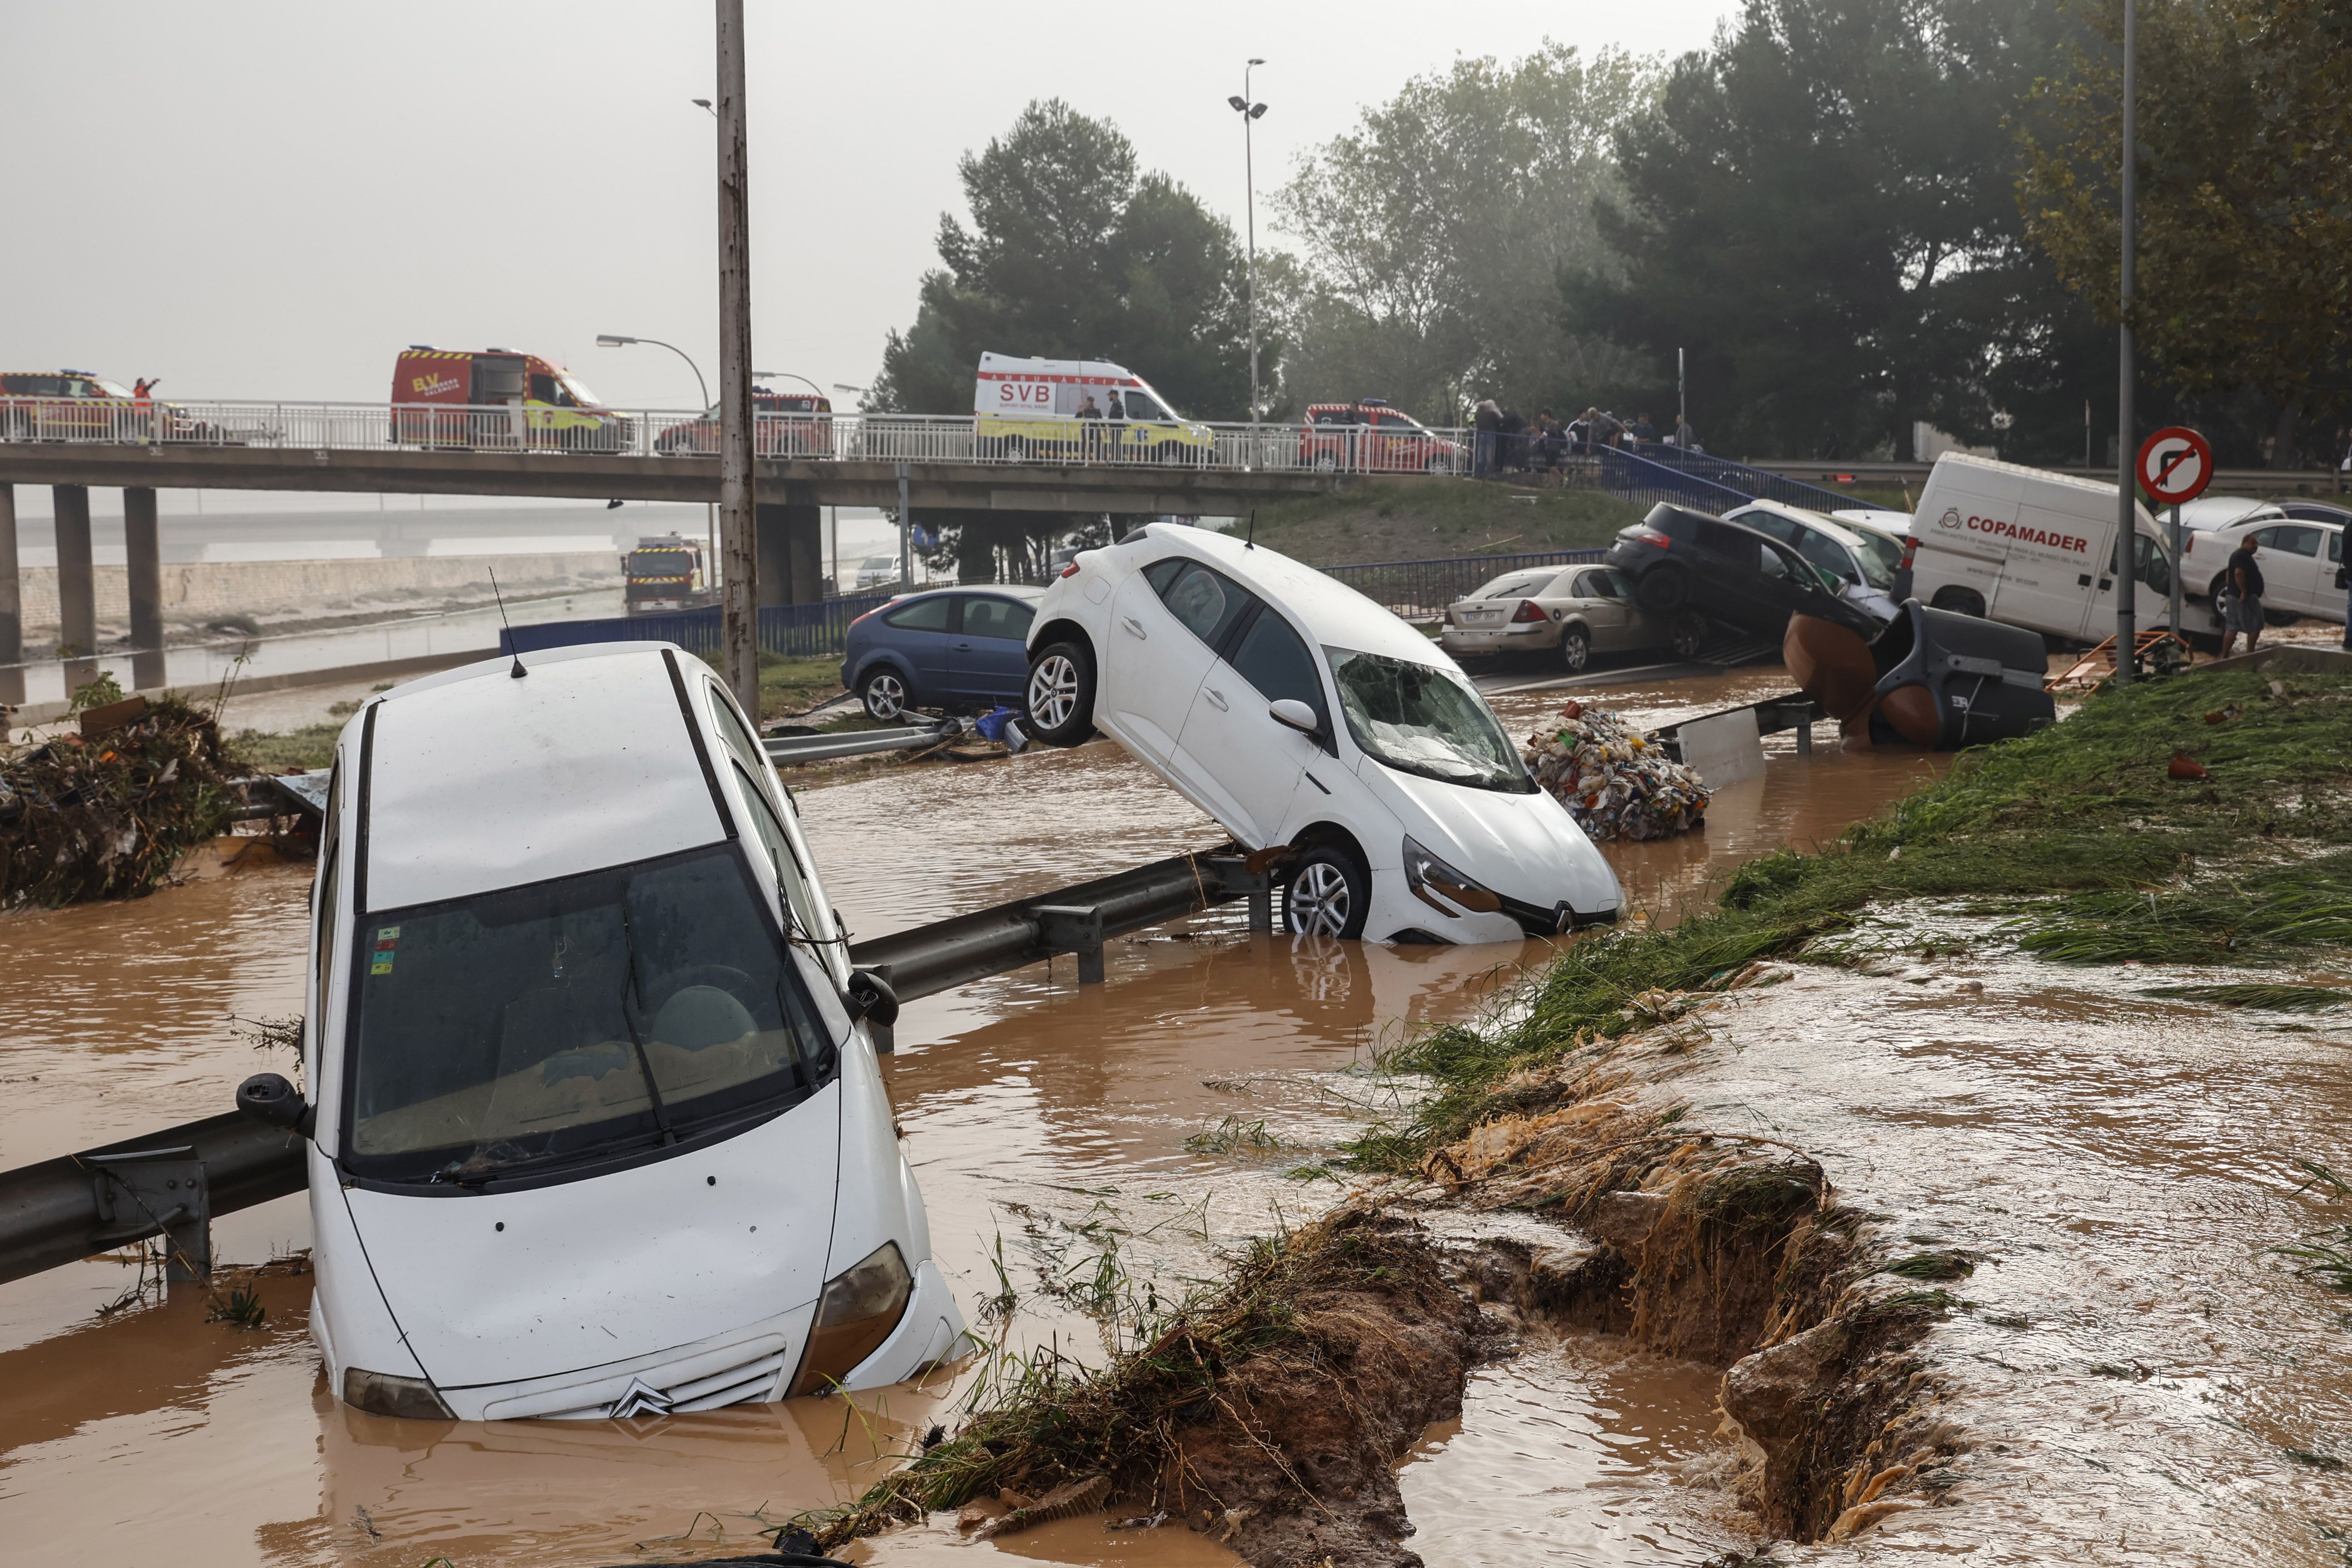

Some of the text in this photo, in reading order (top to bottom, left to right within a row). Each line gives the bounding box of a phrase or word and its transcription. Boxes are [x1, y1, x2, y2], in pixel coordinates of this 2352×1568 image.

[412, 372, 439, 392] BV
[1000, 384, 1049, 403] SVB
[1967, 515, 2087, 554] COPAMADER
